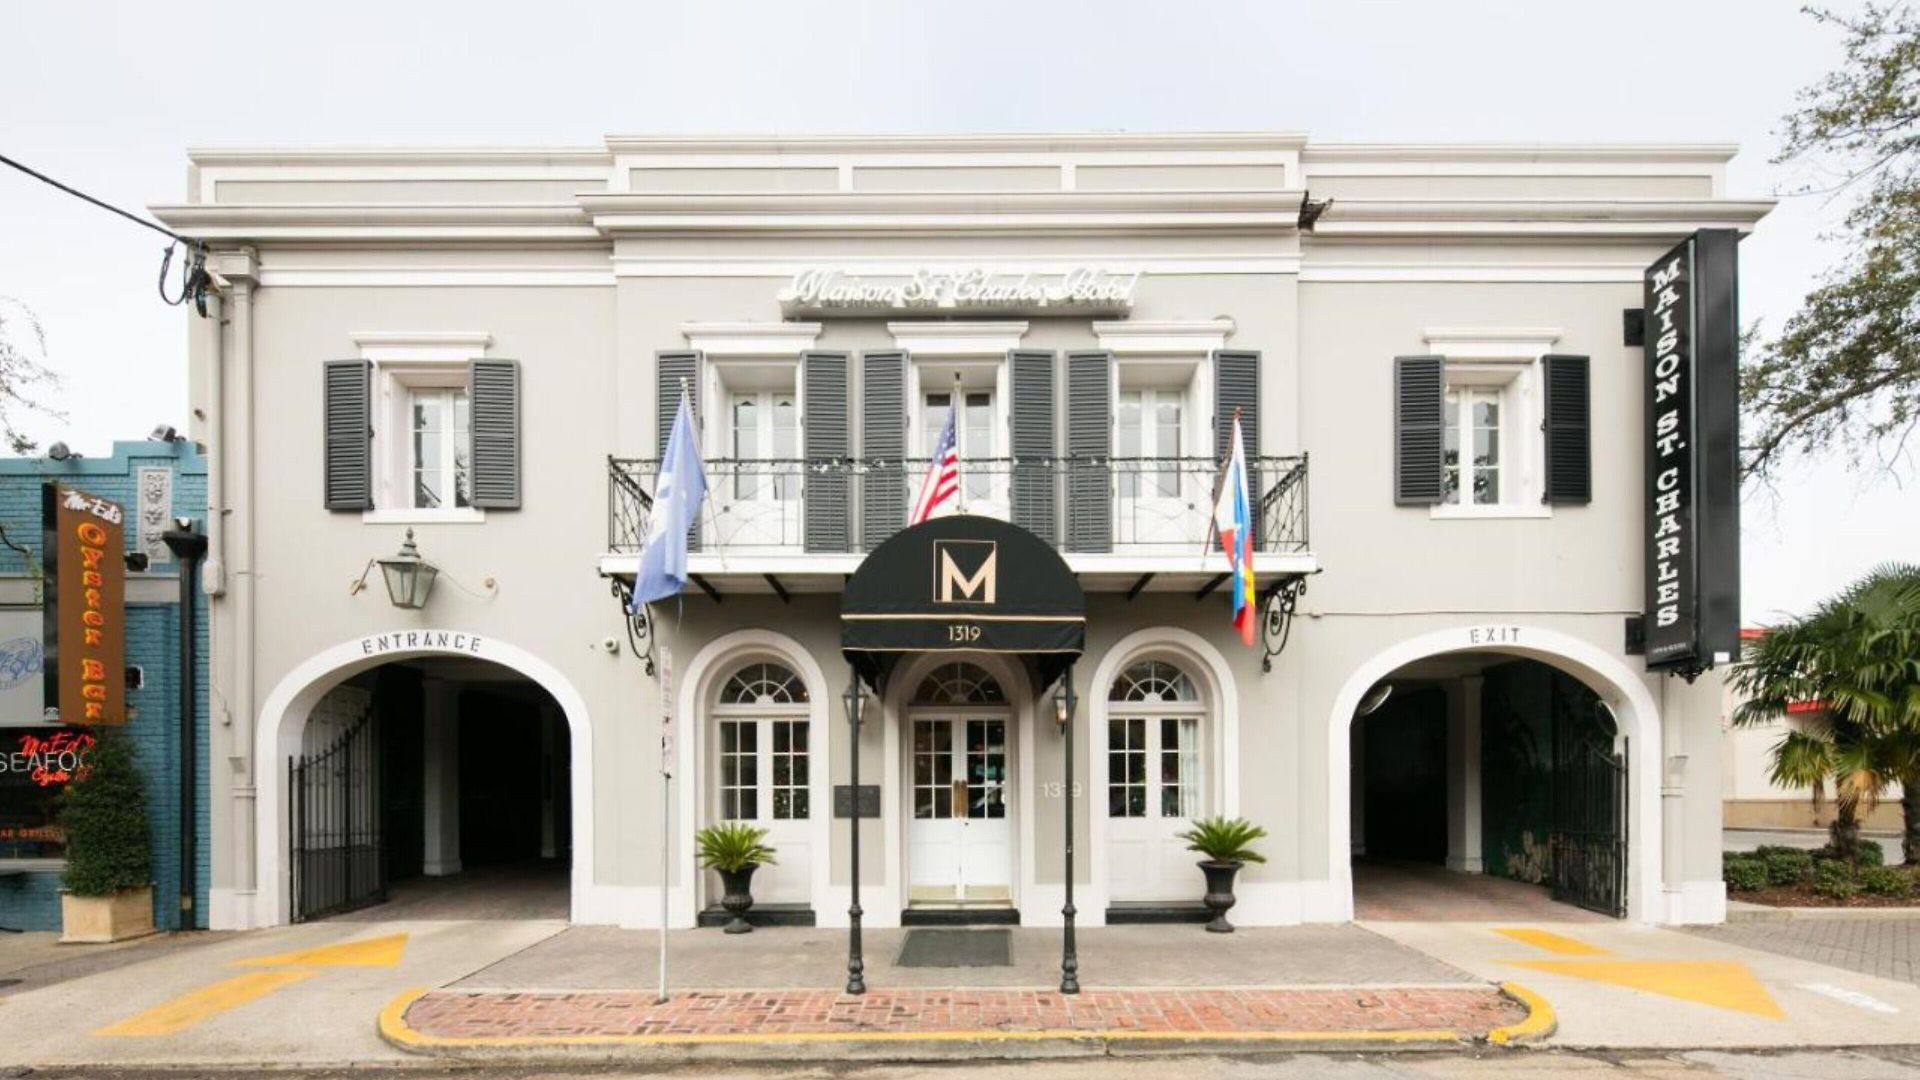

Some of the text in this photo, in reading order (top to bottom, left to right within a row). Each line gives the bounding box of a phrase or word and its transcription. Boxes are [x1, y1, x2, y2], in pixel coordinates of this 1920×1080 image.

[777, 267, 899, 302] Maison
[951, 268, 1043, 302] Charles
[1045, 267, 1139, 303] Hotel
[1652, 257, 1681, 403] MAISON
[1656, 409, 1686, 457] ST.
[1654, 467, 1682, 628] CHARLES
[941, 547, 997, 604] M
[361, 631, 481, 655] ENTRANCE
[948, 625, 981, 641] 1319
[1470, 627, 1521, 643] EXIT
[0, 750, 95, 773] SEAFO
